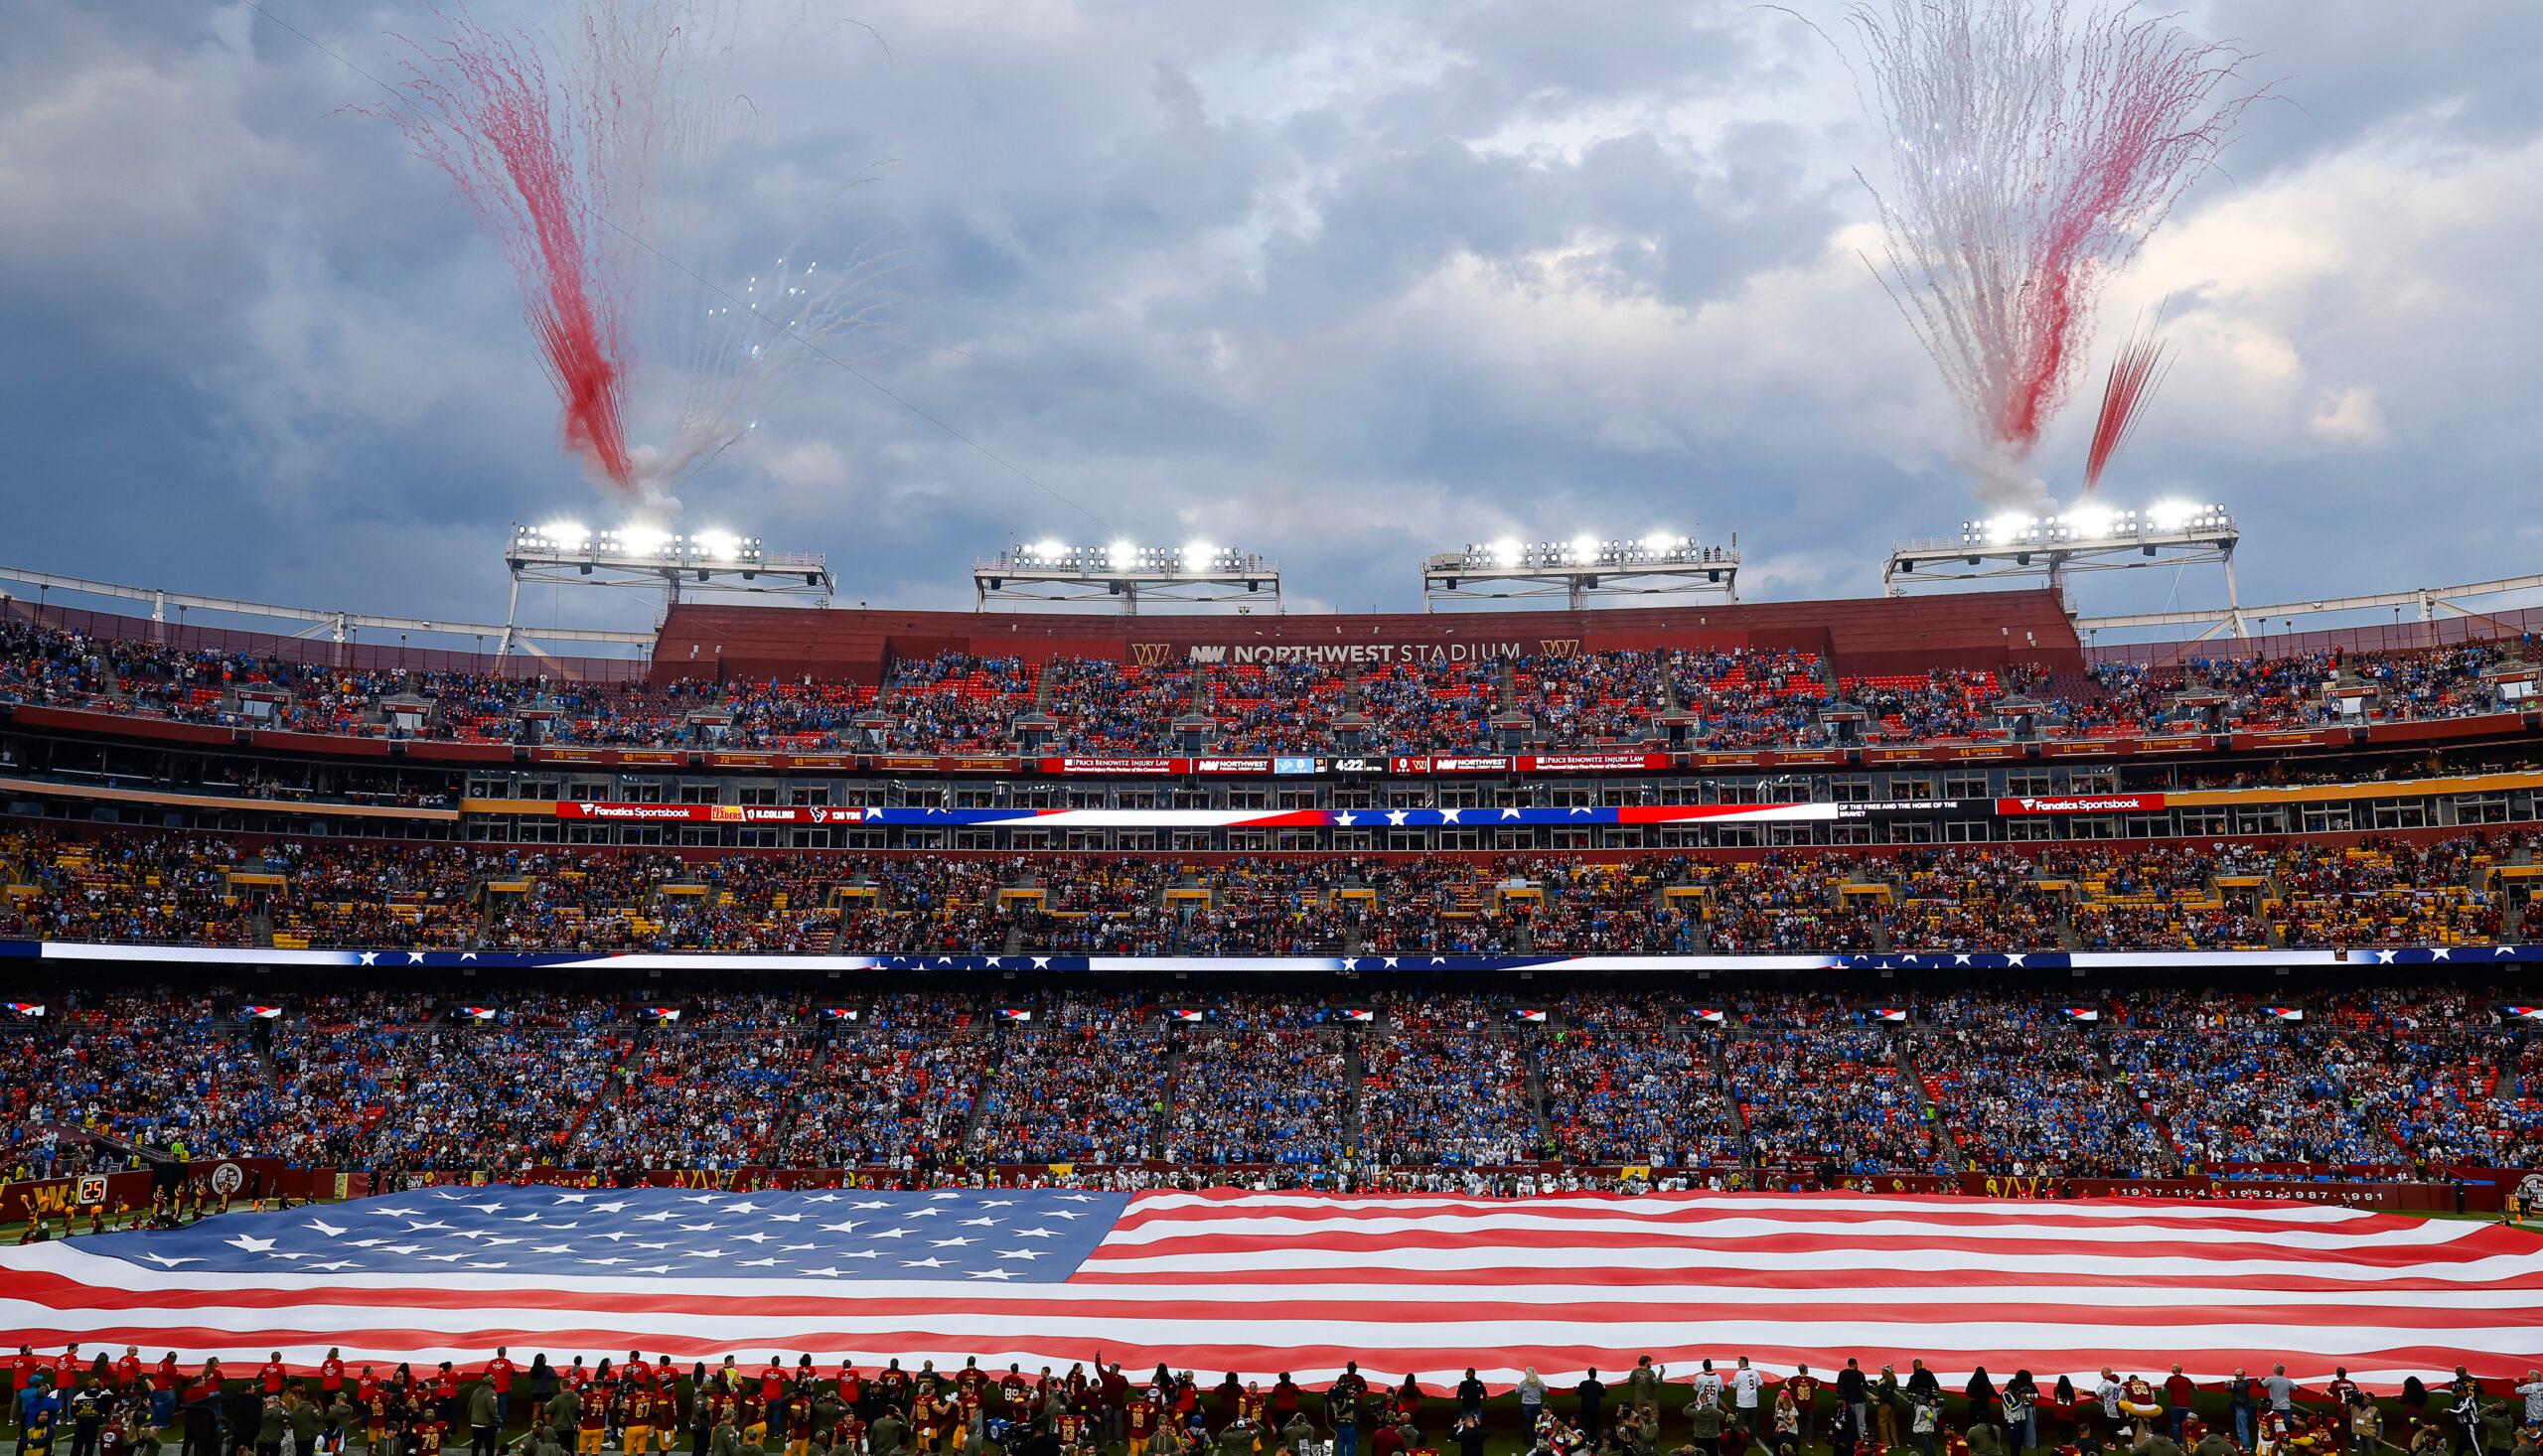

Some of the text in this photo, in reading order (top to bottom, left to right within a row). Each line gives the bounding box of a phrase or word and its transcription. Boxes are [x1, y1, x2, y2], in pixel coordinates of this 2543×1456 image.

[1235, 646, 1395, 662] NORTHWEST
[1401, 643, 1521, 663] STADIUM
[1296, 759, 1304, 769] 0
[1335, 759, 1364, 771] 4:22
[1399, 758, 1408, 769] 0
[2036, 799, 2140, 811] Fanatics Sportsbook
[595, 806, 690, 818] Fanatics Sportsbook
[756, 810, 796, 819] N.COLLINS
[846, 811, 861, 820] YDS
[83, 1181, 103, 1199] 25
[2340, 1192, 2383, 1201] 1991
[1704, 1384, 1717, 1396] 66
[636, 1402, 651, 1418] 67
[422, 1433, 439, 1450] 78
